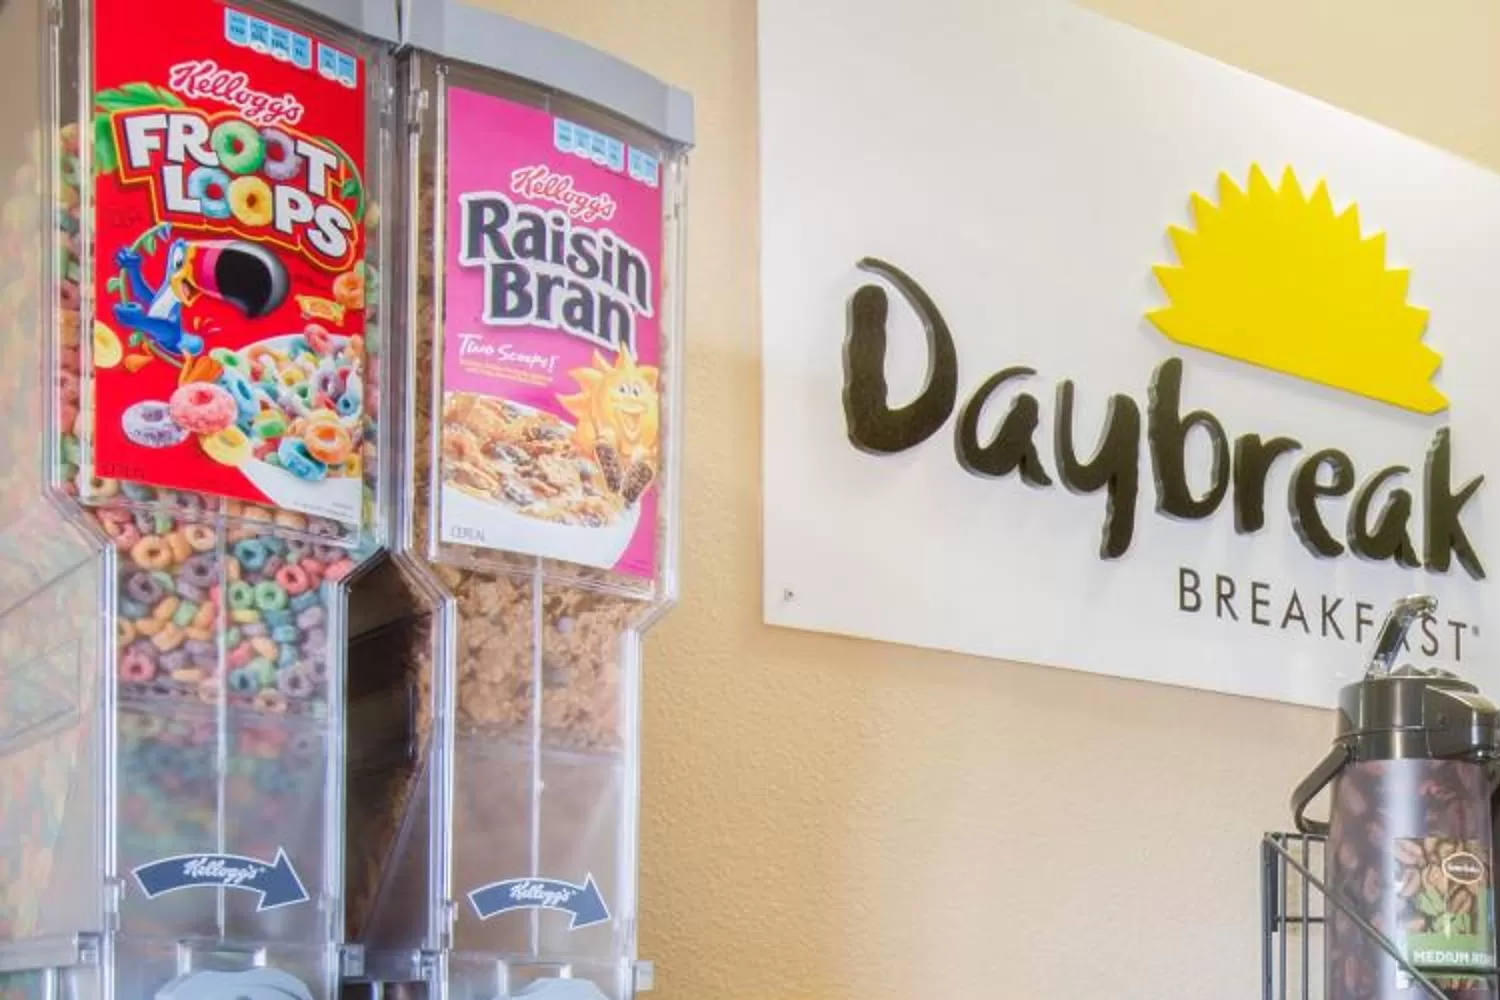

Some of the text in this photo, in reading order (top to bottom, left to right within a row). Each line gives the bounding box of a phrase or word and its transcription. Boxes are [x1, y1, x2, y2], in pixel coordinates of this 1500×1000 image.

[170, 60, 303, 125] Kellogg's
[126, 113, 337, 196] FROOT
[163, 166, 352, 260] LOOPS
[510, 167, 616, 222] Kellogg's
[464, 198, 650, 312] Raisin
[487, 262, 635, 352] Bran
[458, 333, 494, 356] Two
[842, 256, 1487, 581] Daybreak
[183, 857, 257, 885] Kellogg's
[510, 880, 570, 905] Kellogg's
